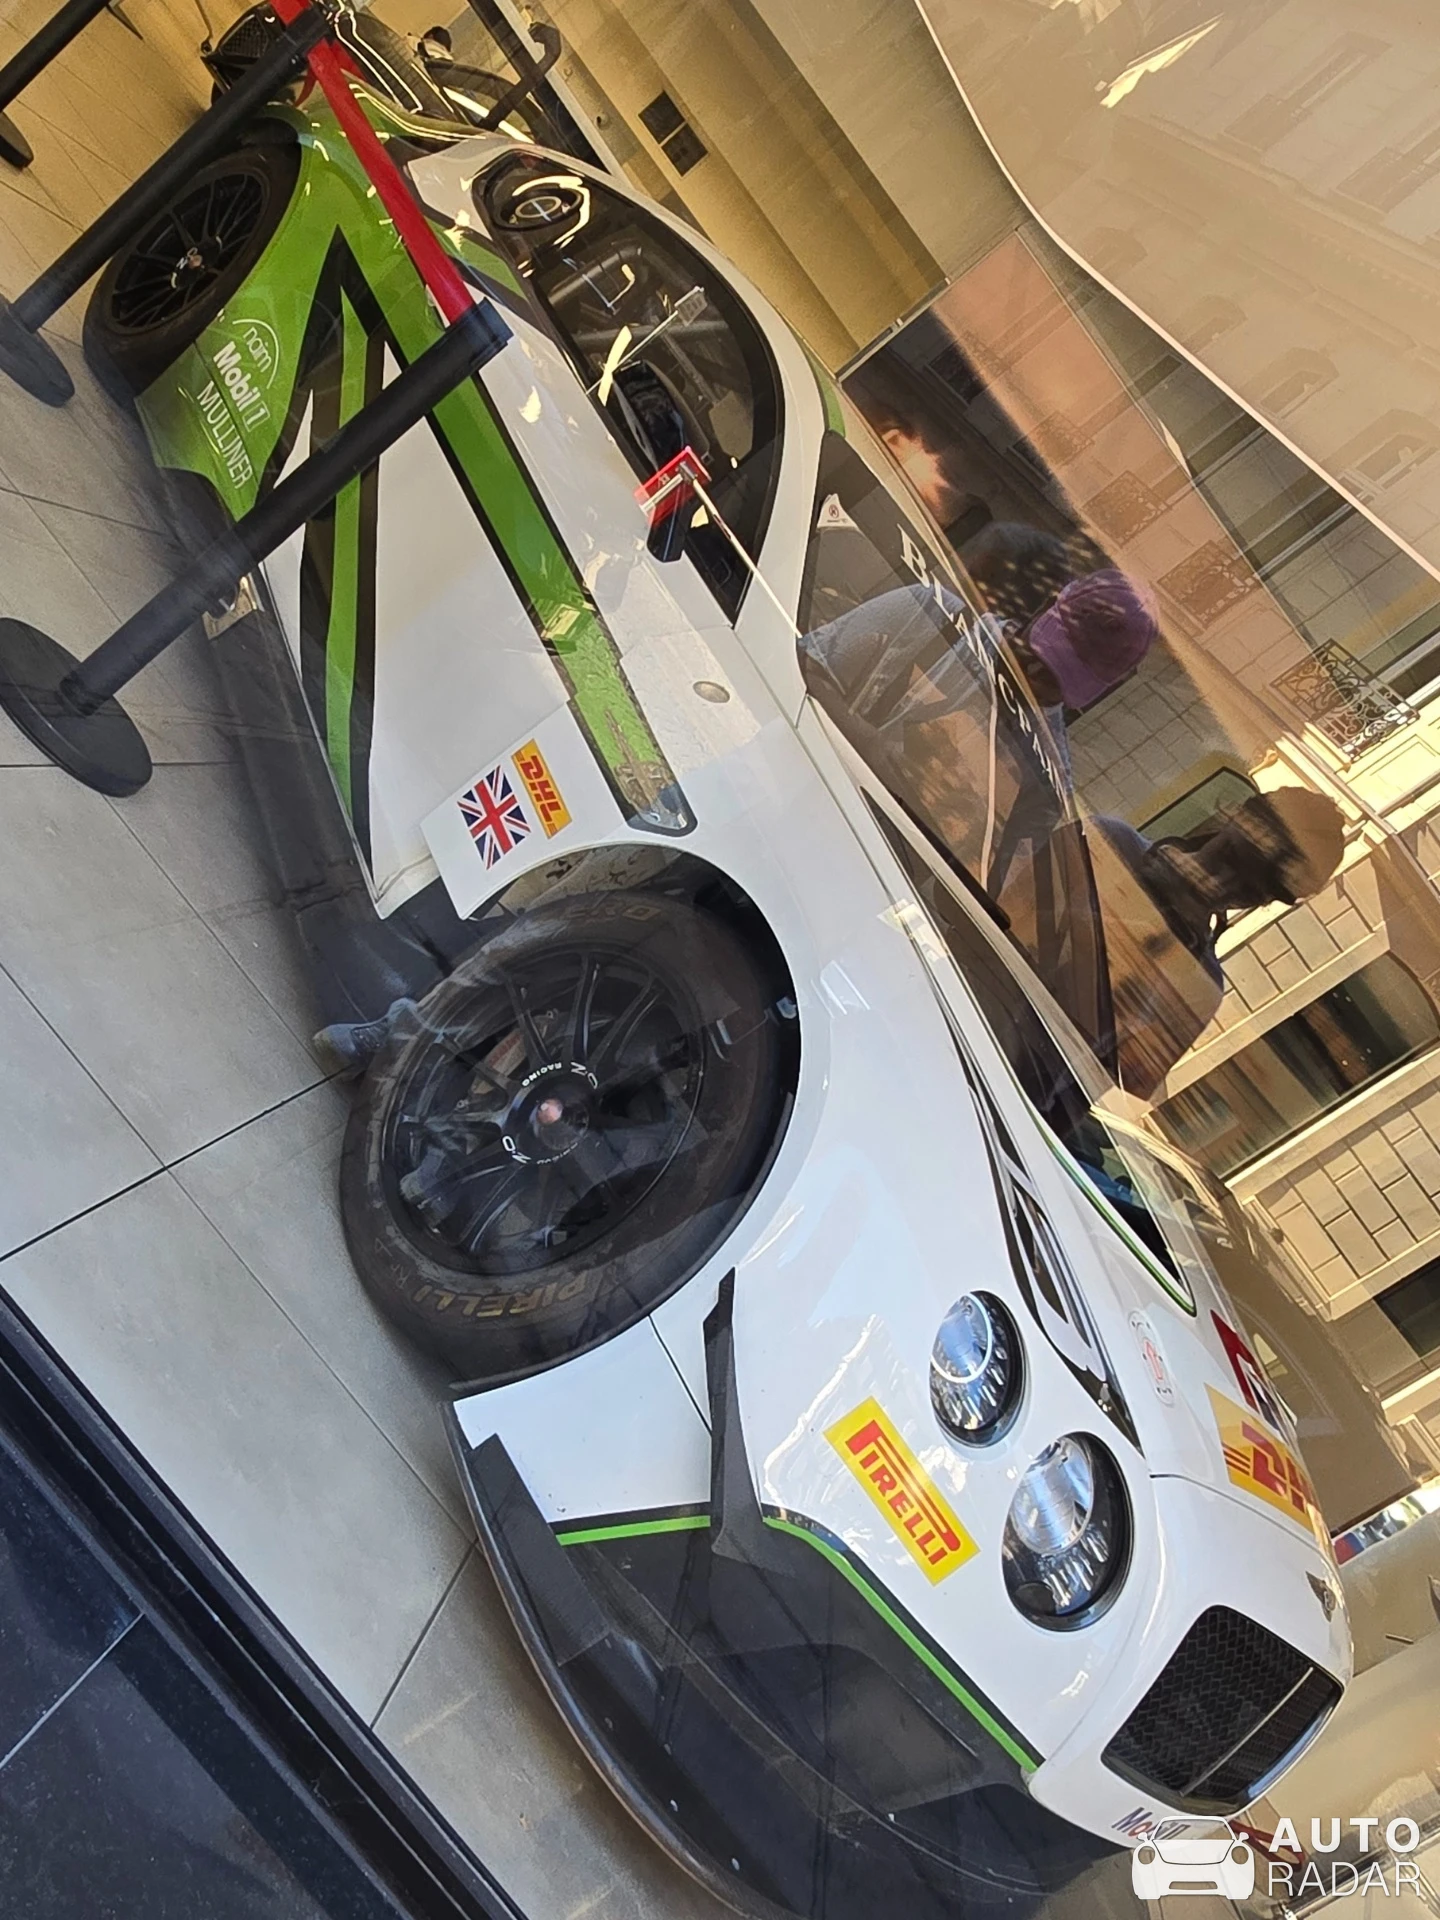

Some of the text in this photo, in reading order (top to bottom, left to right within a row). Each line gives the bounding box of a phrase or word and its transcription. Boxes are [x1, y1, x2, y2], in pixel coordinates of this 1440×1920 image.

[213, 341, 269, 429] Mobil 1
[243, 326, 272, 373] naim
[197, 380, 253, 489] MULLINER
[520, 755, 561, 822] DHL
[412, 1269, 589, 1319] PIRELLI
[845, 1419, 961, 1565] PIRELLI
[1241, 1421, 1323, 1515] DH
